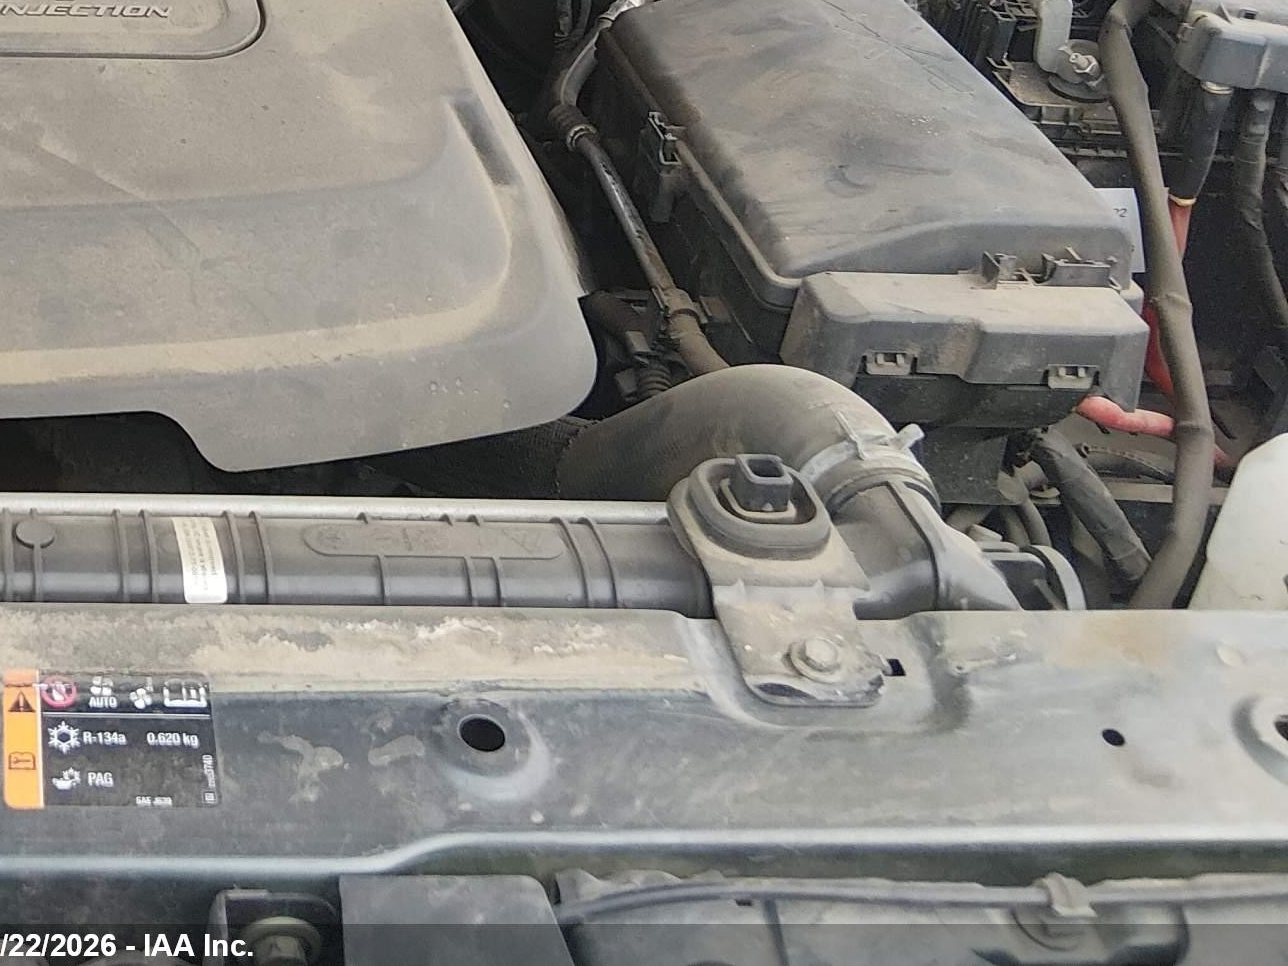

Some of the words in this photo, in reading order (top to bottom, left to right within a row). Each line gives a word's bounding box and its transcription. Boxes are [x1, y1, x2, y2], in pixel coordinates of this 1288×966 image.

[89, 696, 118, 708] AUTO
[83, 731, 127, 745] R-134a
[146, 732, 181, 746] 0.620
[182, 732, 200, 749] kg
[87, 772, 114, 787] PAG
